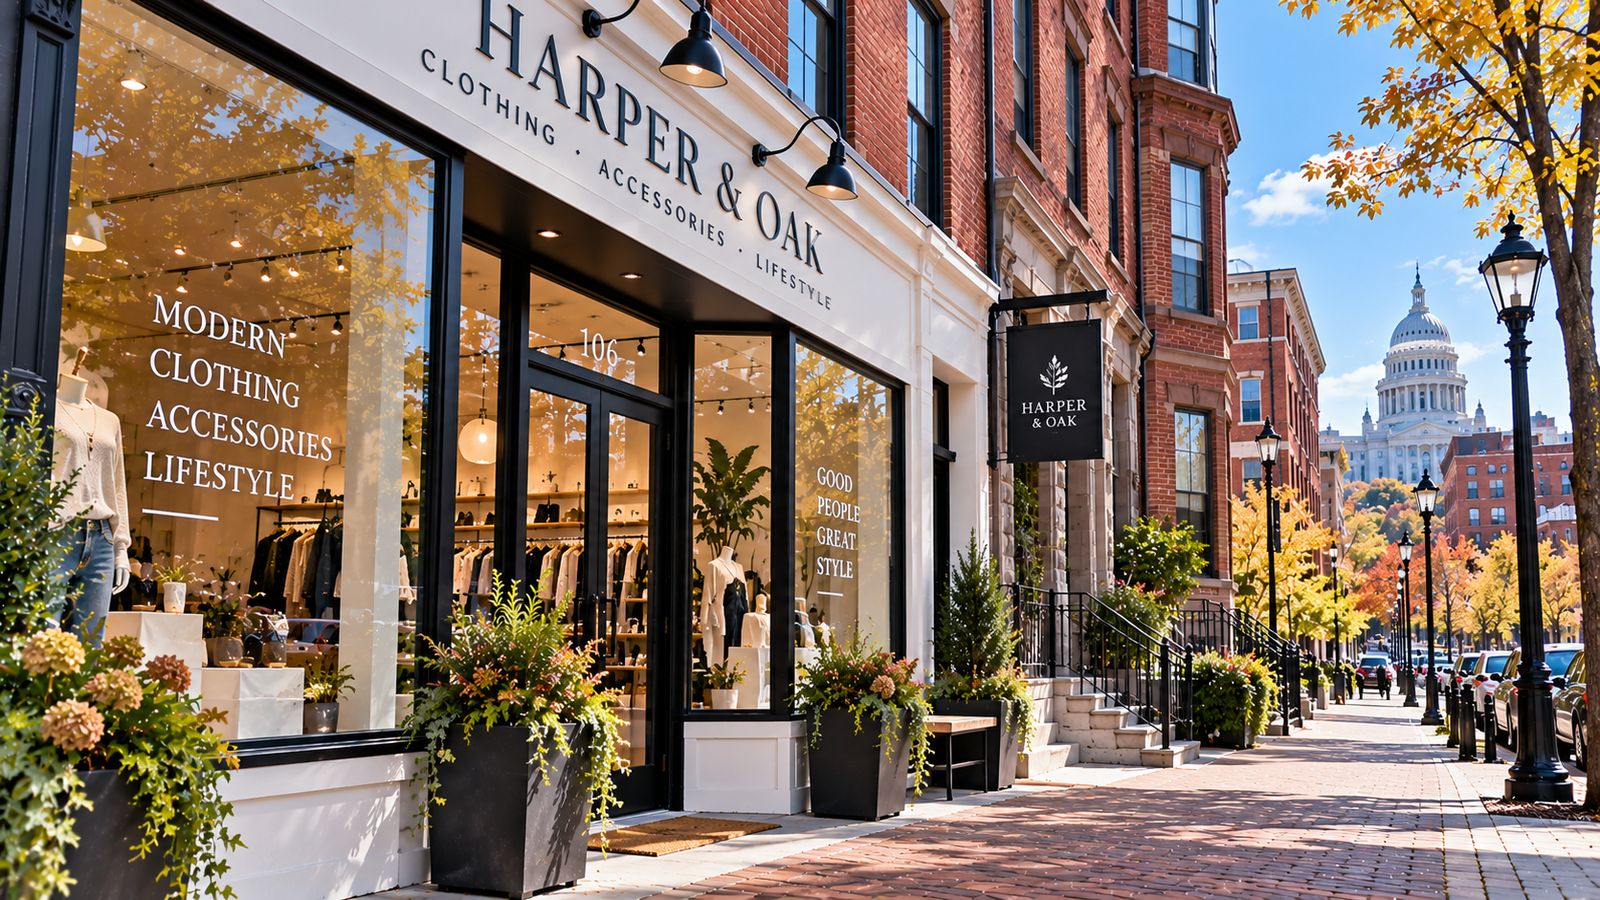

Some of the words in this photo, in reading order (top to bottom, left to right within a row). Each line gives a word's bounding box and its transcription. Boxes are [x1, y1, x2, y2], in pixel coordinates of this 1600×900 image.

[475, 0, 702, 195] HARPER
[716, 162, 743, 221] &
[756, 191, 824, 275] OAK
[421, 48, 556, 146] CLOTHING
[599, 159, 725, 247] ACCESSORIES
[755, 253, 832, 311] LIFESTYLE
[152, 294, 287, 359] MODERN
[580, 328, 618, 367] 106
[149, 348, 300, 408] CLOTHING
[1022, 399, 1087, 414] HARPER
[1032, 418, 1042, 429] &
[1046, 415, 1077, 428] OAK
[146, 400, 333, 462] ACCESSORIES
[143, 450, 295, 500] LIFESTYLE
[817, 467, 853, 493] GOOD
[817, 496, 861, 523] PEOPLE
[817, 526, 857, 550] GREAT
[816, 556, 854, 580] STYLE
